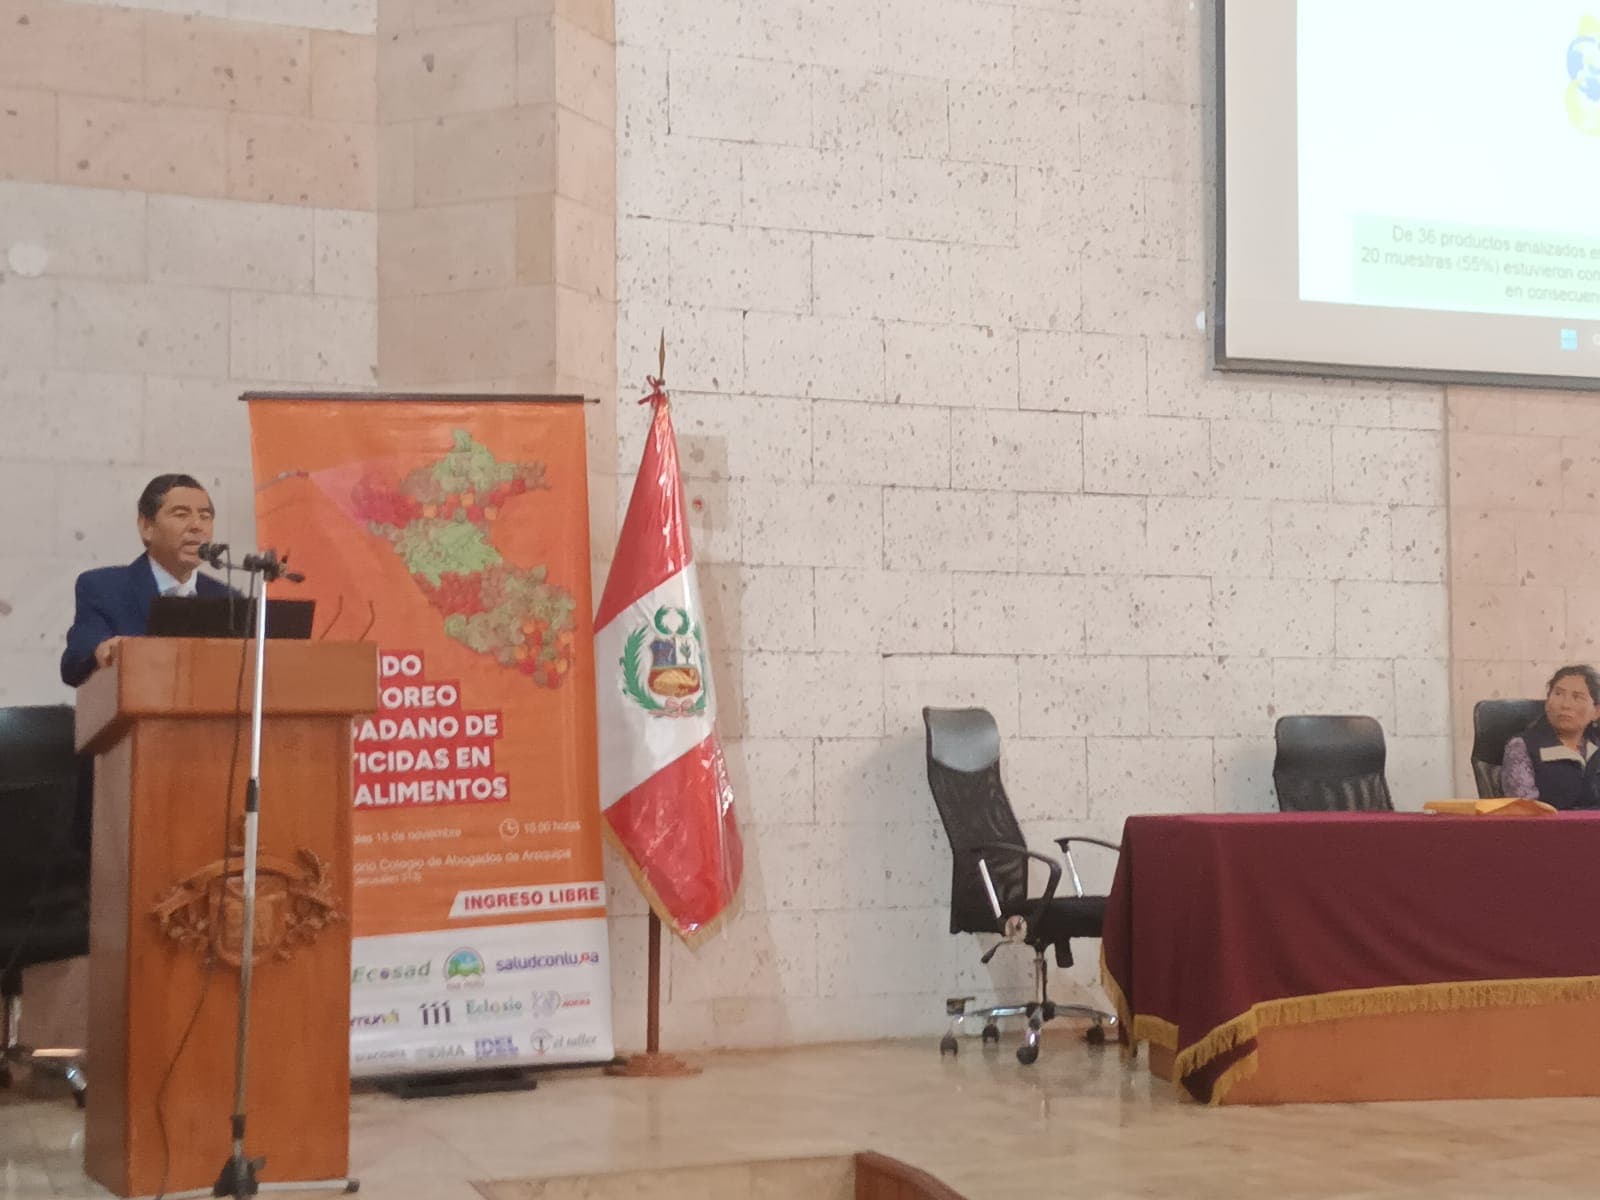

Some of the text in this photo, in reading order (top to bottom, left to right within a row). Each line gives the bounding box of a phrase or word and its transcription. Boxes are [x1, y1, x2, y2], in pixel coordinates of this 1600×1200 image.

[1440, 229, 1511, 252] productos
[1514, 238, 1585, 259] analizados
[1360, 246, 1380, 264] 20
[1384, 250, 1452, 270] muestras
[1503, 260, 1573, 280] estuvieron
[1505, 285, 1523, 298] en
[377, 653, 423, 678] DO
[378, 684, 458, 710] OREO
[465, 713, 499, 736] DE
[456, 745, 491, 768] EN
[353, 776, 508, 808] ALIMENTOS
[444, 850, 504, 868] Abogados
[464, 886, 601, 912] INGRESO LIBRE
